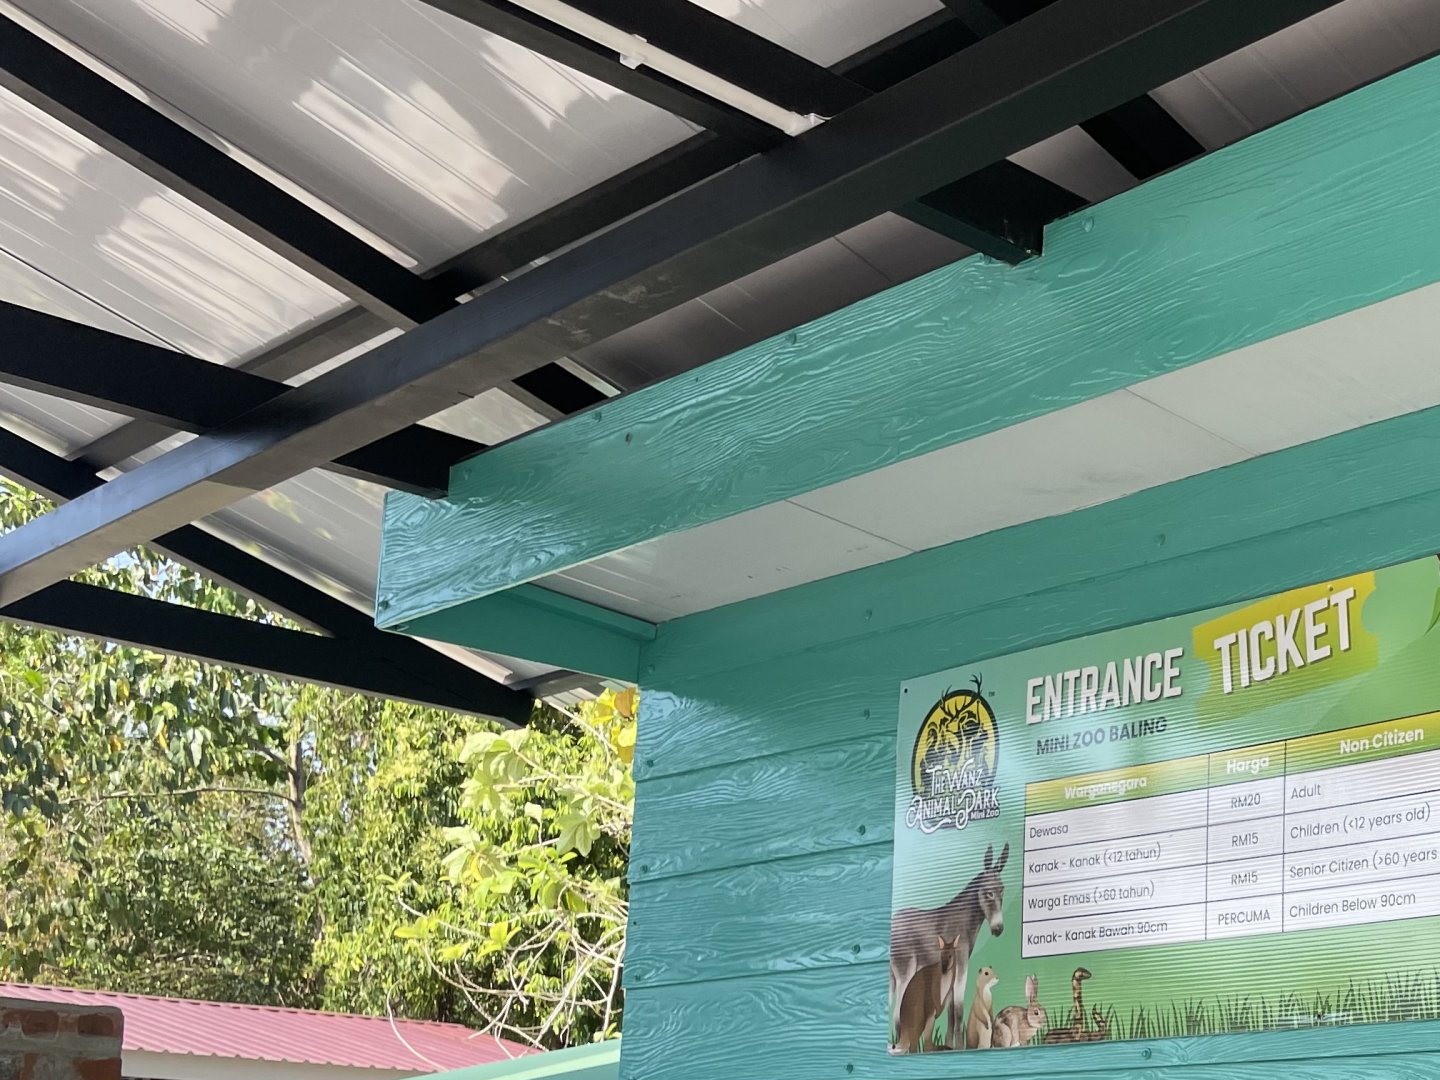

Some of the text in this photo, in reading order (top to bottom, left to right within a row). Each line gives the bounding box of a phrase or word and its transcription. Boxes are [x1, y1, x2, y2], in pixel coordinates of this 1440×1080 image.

[1025, 586, 1355, 725] ENTRANCE TICKET
[1036, 716, 1168, 755] MINI ZOO BALING
[1340, 727, 1425, 755] Non Citizen
[1227, 756, 1270, 775] Harga
[1231, 792, 1261, 809] RM20
[1291, 784, 1321, 800] Adult
[1029, 823, 1069, 839] Dewasa
[1290, 801, 1431, 839] Children (<12 years old)
[1231, 832, 1259, 848] RM15
[1029, 860, 1059, 874] Kanak
[1069, 854, 1101, 869] Kanak
[1126, 841, 1161, 862] tahun)
[1290, 863, 1326, 879] Senior
[1329, 857, 1369, 874] Citizen
[1372, 850, 1400, 870] (>60
[1402, 848, 1438, 867] years
[1231, 871, 1258, 886] RM15
[1028, 895, 1061, 911] Warga
[1063, 892, 1091, 906] Emas
[1119, 880, 1155, 900] tahun)
[1290, 892, 1416, 918] Children Below 90cm
[1218, 909, 1271, 926] PERCUMA
[1065, 927, 1097, 941] Kanak
[1099, 923, 1135, 938] Bawah
[1137, 921, 1168, 935] 90cm
